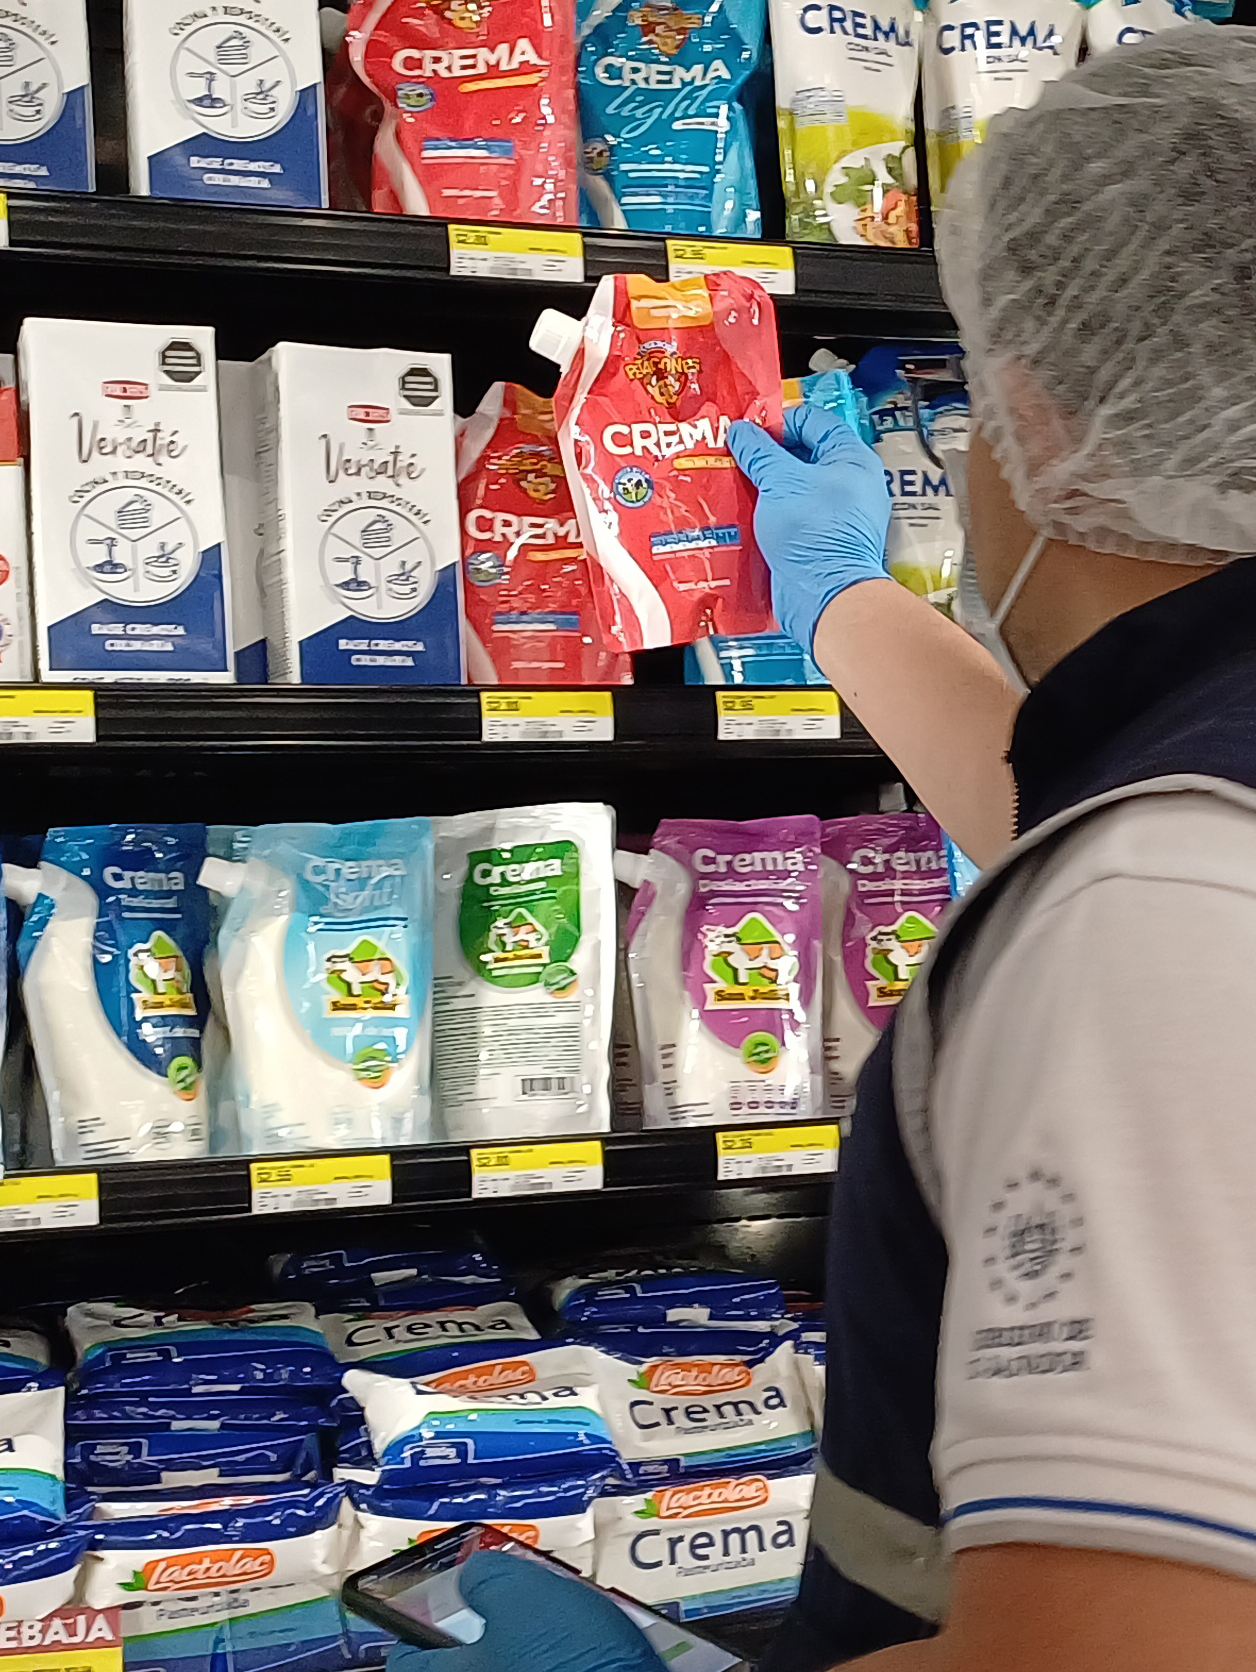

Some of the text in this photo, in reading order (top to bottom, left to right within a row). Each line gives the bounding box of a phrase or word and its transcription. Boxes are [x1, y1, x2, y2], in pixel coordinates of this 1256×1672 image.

[936, 19, 1061, 56] CREMA
[391, 37, 551, 78] CREMA
[594, 55, 731, 89] CREMA
[605, 84, 735, 138] light
[883, 468, 955, 498] REM
[464, 507, 584, 545] CREM
[305, 858, 408, 883] Crema
[473, 858, 564, 886] Crema
[693, 847, 805, 874] Crema
[103, 865, 186, 891] Crema
[344, 1317, 515, 1347] Crema
[428, 1364, 532, 1395] actolac
[650, 1363, 748, 1395] Lactolac
[629, 1385, 788, 1430] Crema
[660, 1479, 767, 1518] Lactolac
[629, 1519, 797, 1571] Crema
[147, 1549, 273, 1593] Lactolac
[0, 1613, 116, 1648] EBAJA
